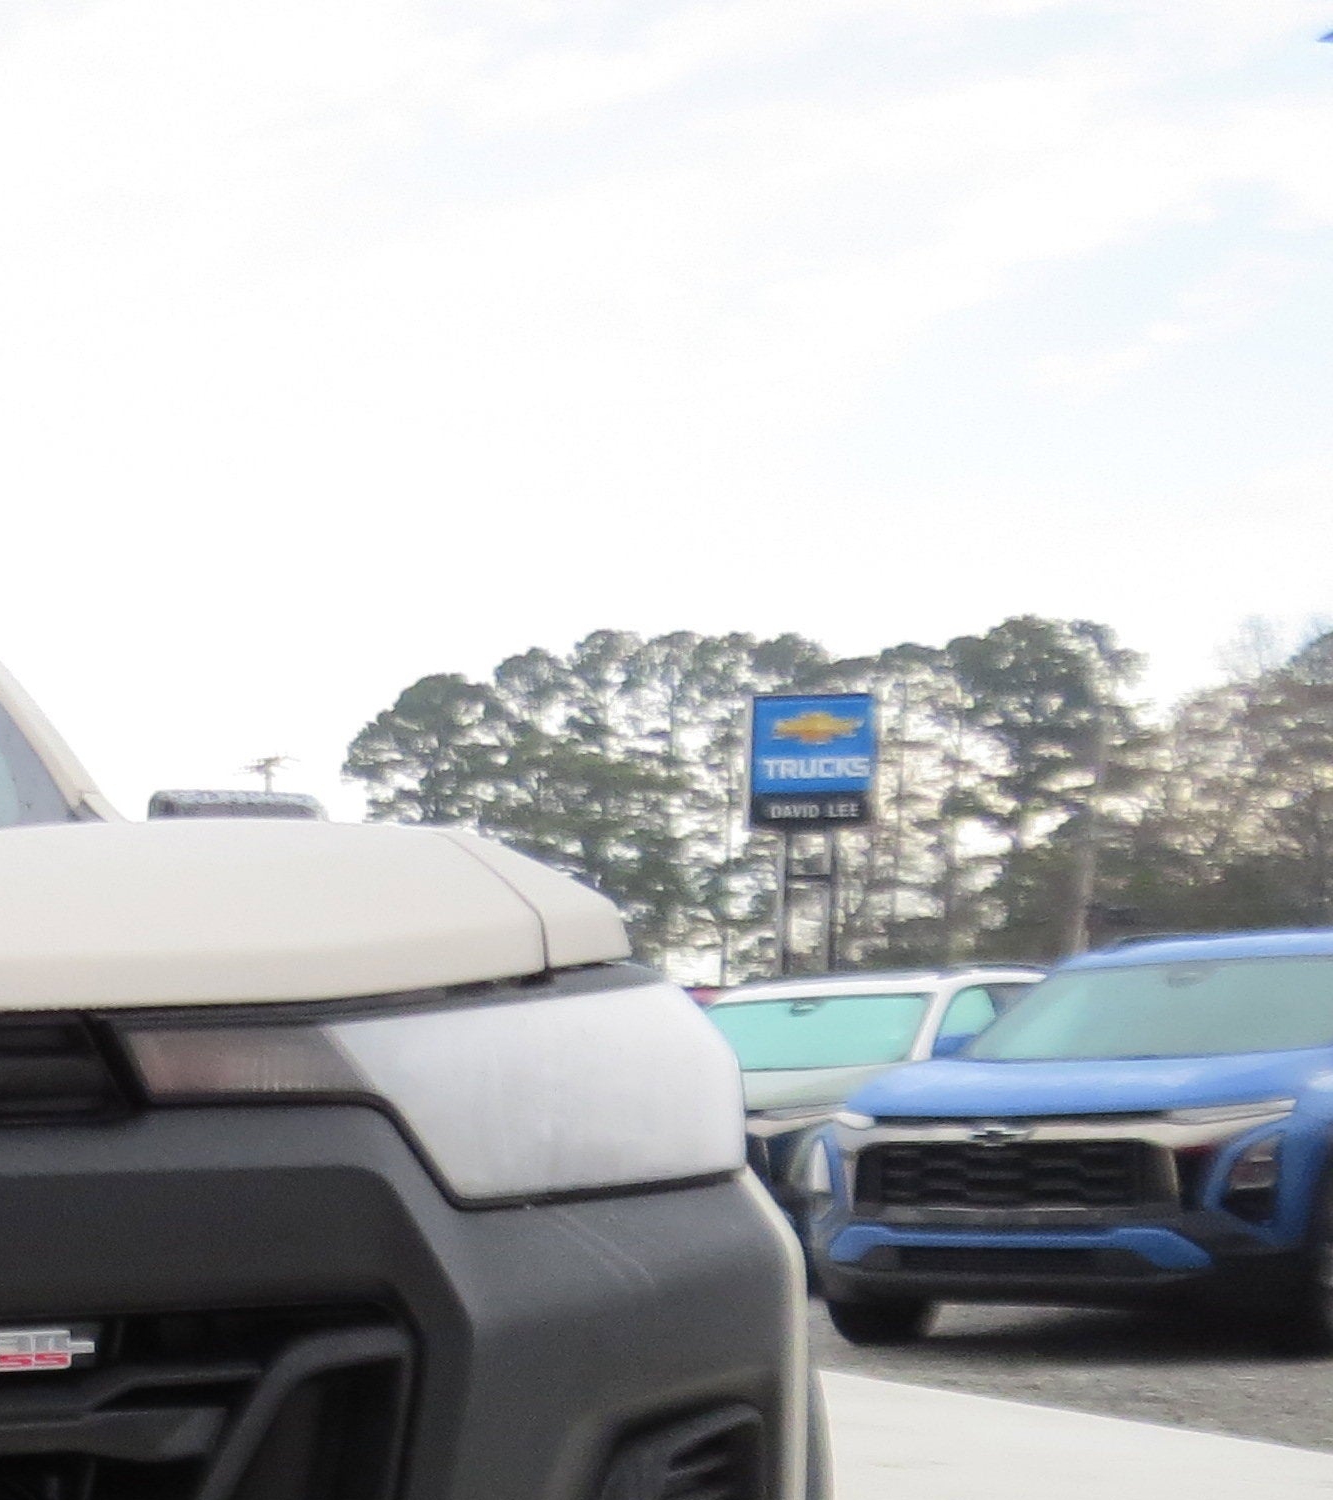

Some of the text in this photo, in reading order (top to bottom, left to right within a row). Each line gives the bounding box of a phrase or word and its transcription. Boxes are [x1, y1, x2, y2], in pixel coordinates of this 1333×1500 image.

[763, 758, 870, 779] TRUCKS
[770, 802, 861, 819] DAVID LEE
